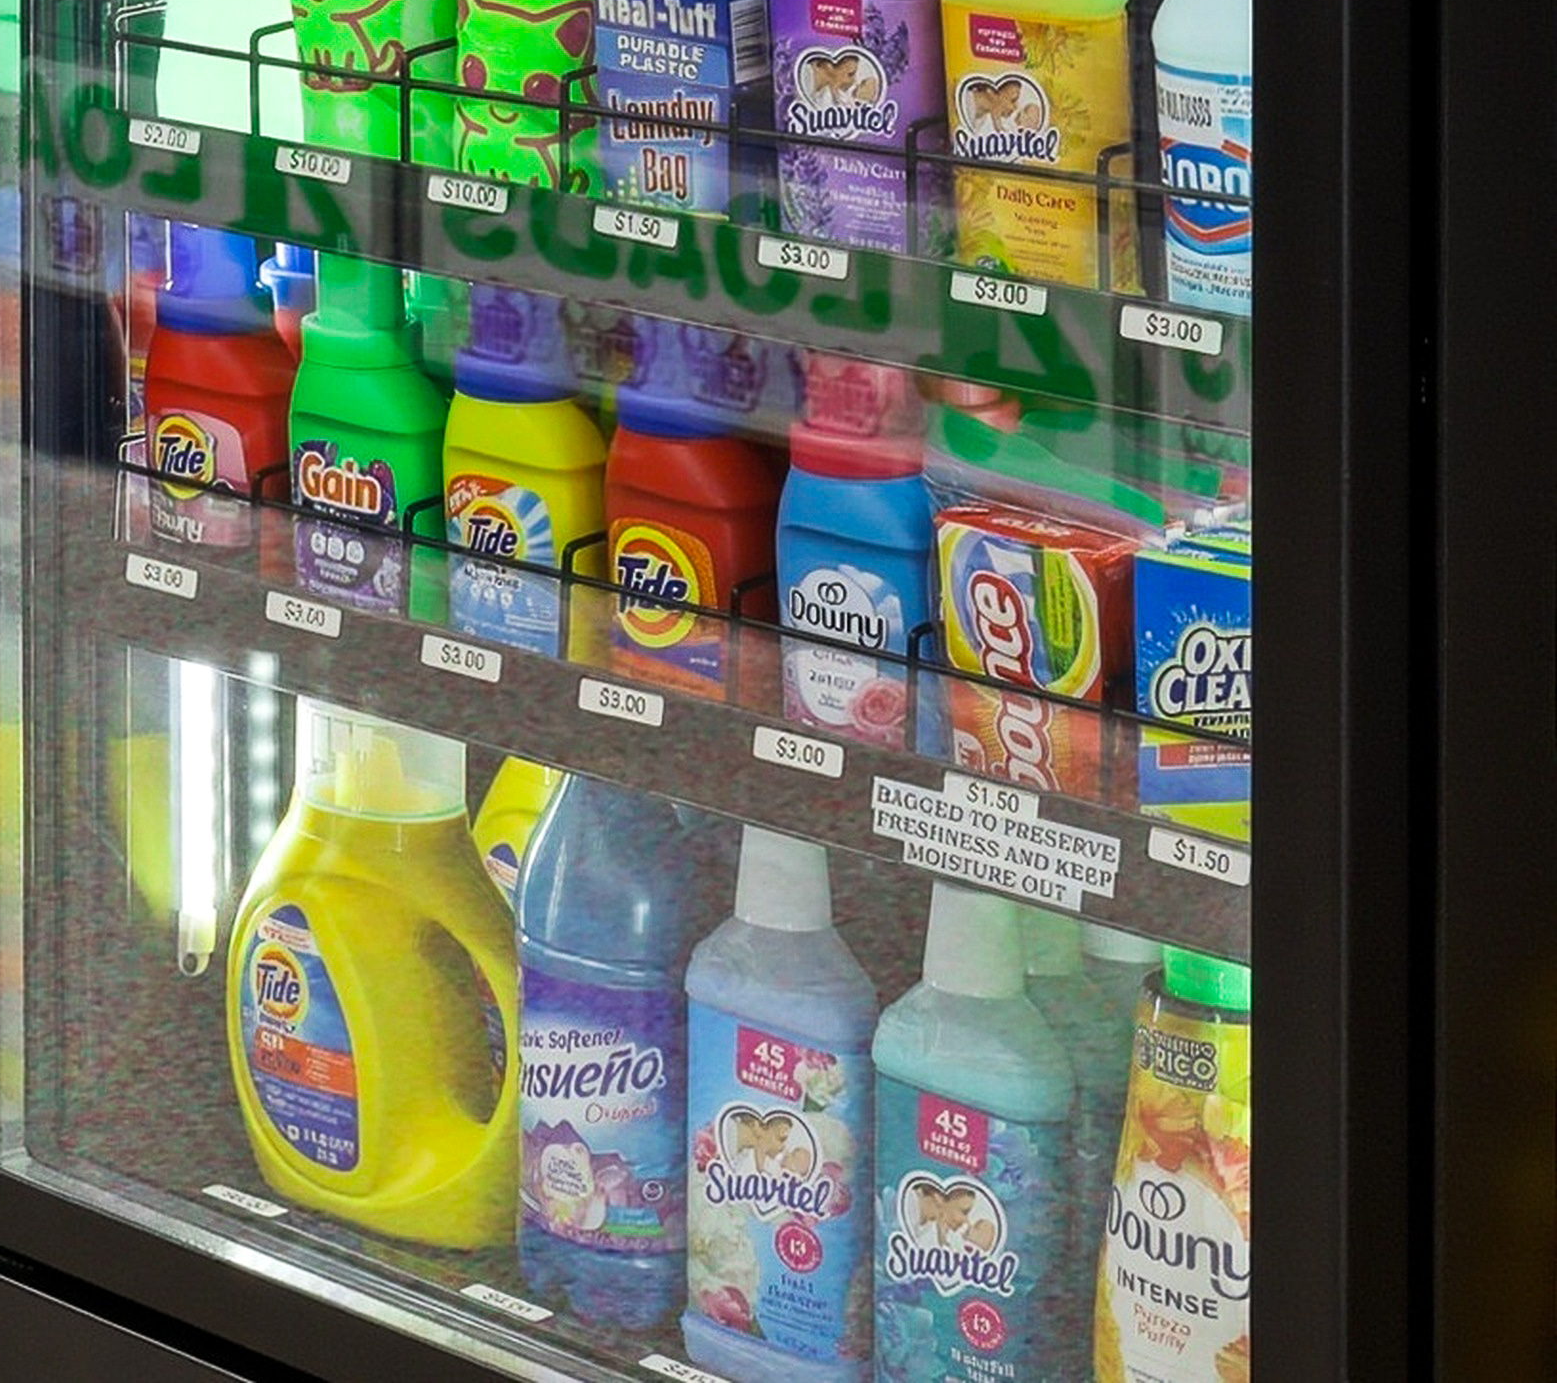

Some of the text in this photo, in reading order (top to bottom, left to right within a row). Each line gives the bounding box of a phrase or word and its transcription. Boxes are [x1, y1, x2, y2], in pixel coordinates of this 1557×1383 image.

[617, 34, 705, 63] DURABLE
[619, 53, 699, 81] PLASTIC
[144, 122, 187, 149] $2.00
[791, 100, 899, 136] Suavitel
[289, 149, 341, 177] $10.00
[955, 128, 1060, 163] Suavitel
[641, 147, 689, 199] Bag
[442, 181, 498, 207] $10.00
[996, 184, 1077, 211] Daily Care
[615, 211, 661, 239] $1.50
[780, 243, 831, 270] $3.00
[974, 277, 1029, 306] $3.00
[1145, 313, 1203, 344] $3.00
[159, 436, 207, 475] Tide
[301, 453, 381, 513] Gain
[468, 518, 518, 557] Tide
[144, 564, 183, 589] $3.00
[617, 554, 689, 614] Tide
[284, 599, 326, 627] $3.00
[791, 589, 884, 649] Downy
[441, 644, 485, 671] $3.00
[599, 687, 647, 715] $3.00
[1159, 666, 1251, 716] CLEA
[776, 737, 825, 767] $3.00
[966, 780, 1020, 814] $1.50
[875, 782, 1117, 864] BAGGED TO PRESERVE
[875, 809, 1114, 888] FRESHNESS AND KEEP
[1173, 838, 1231, 875] $1.50
[907, 841, 1067, 903] MOISTURE OUT
[257, 962, 301, 1005] Tide
[753, 1041, 785, 1070] 45
[1155, 1045, 1217, 1081] RICO
[934, 1109, 969, 1139] 45
[706, 1162, 828, 1217] Suavitel
[1107, 1185, 1251, 1301] Downy
[888, 1233, 1016, 1294] Suavitel
[1116, 1265, 1220, 1320] INTENSE
